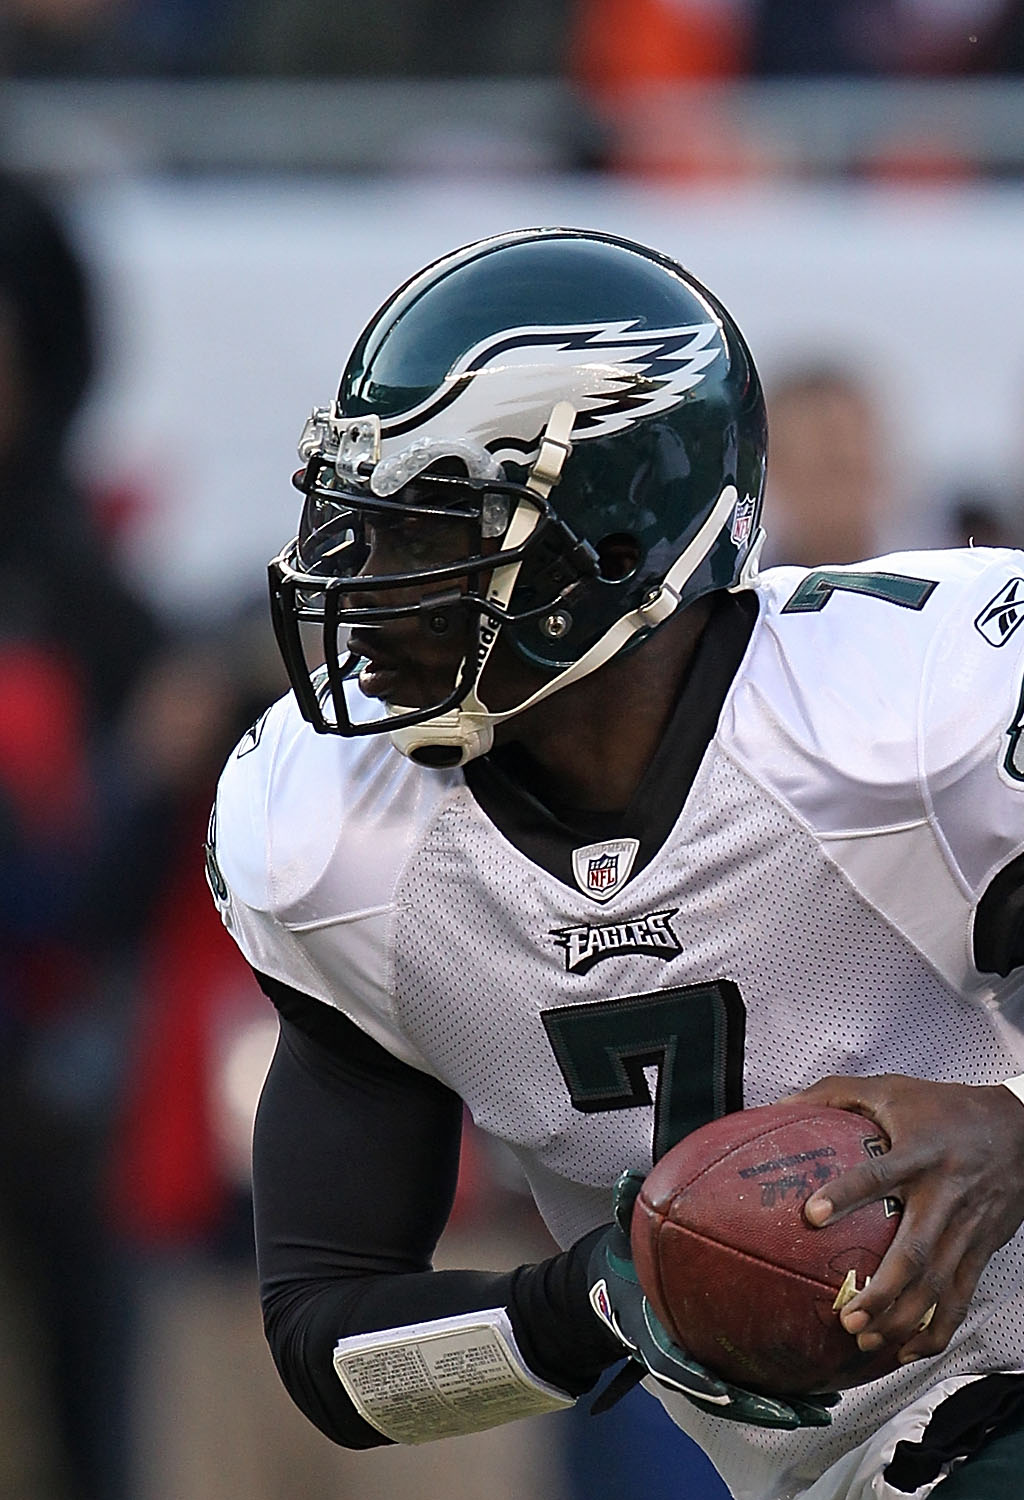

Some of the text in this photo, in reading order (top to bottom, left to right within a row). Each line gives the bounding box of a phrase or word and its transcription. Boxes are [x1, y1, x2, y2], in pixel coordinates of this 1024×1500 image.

[780, 571, 940, 615] 7
[590, 866, 615, 888] NFL
[559, 909, 683, 974] EAGLES
[540, 978, 746, 1168] 7
